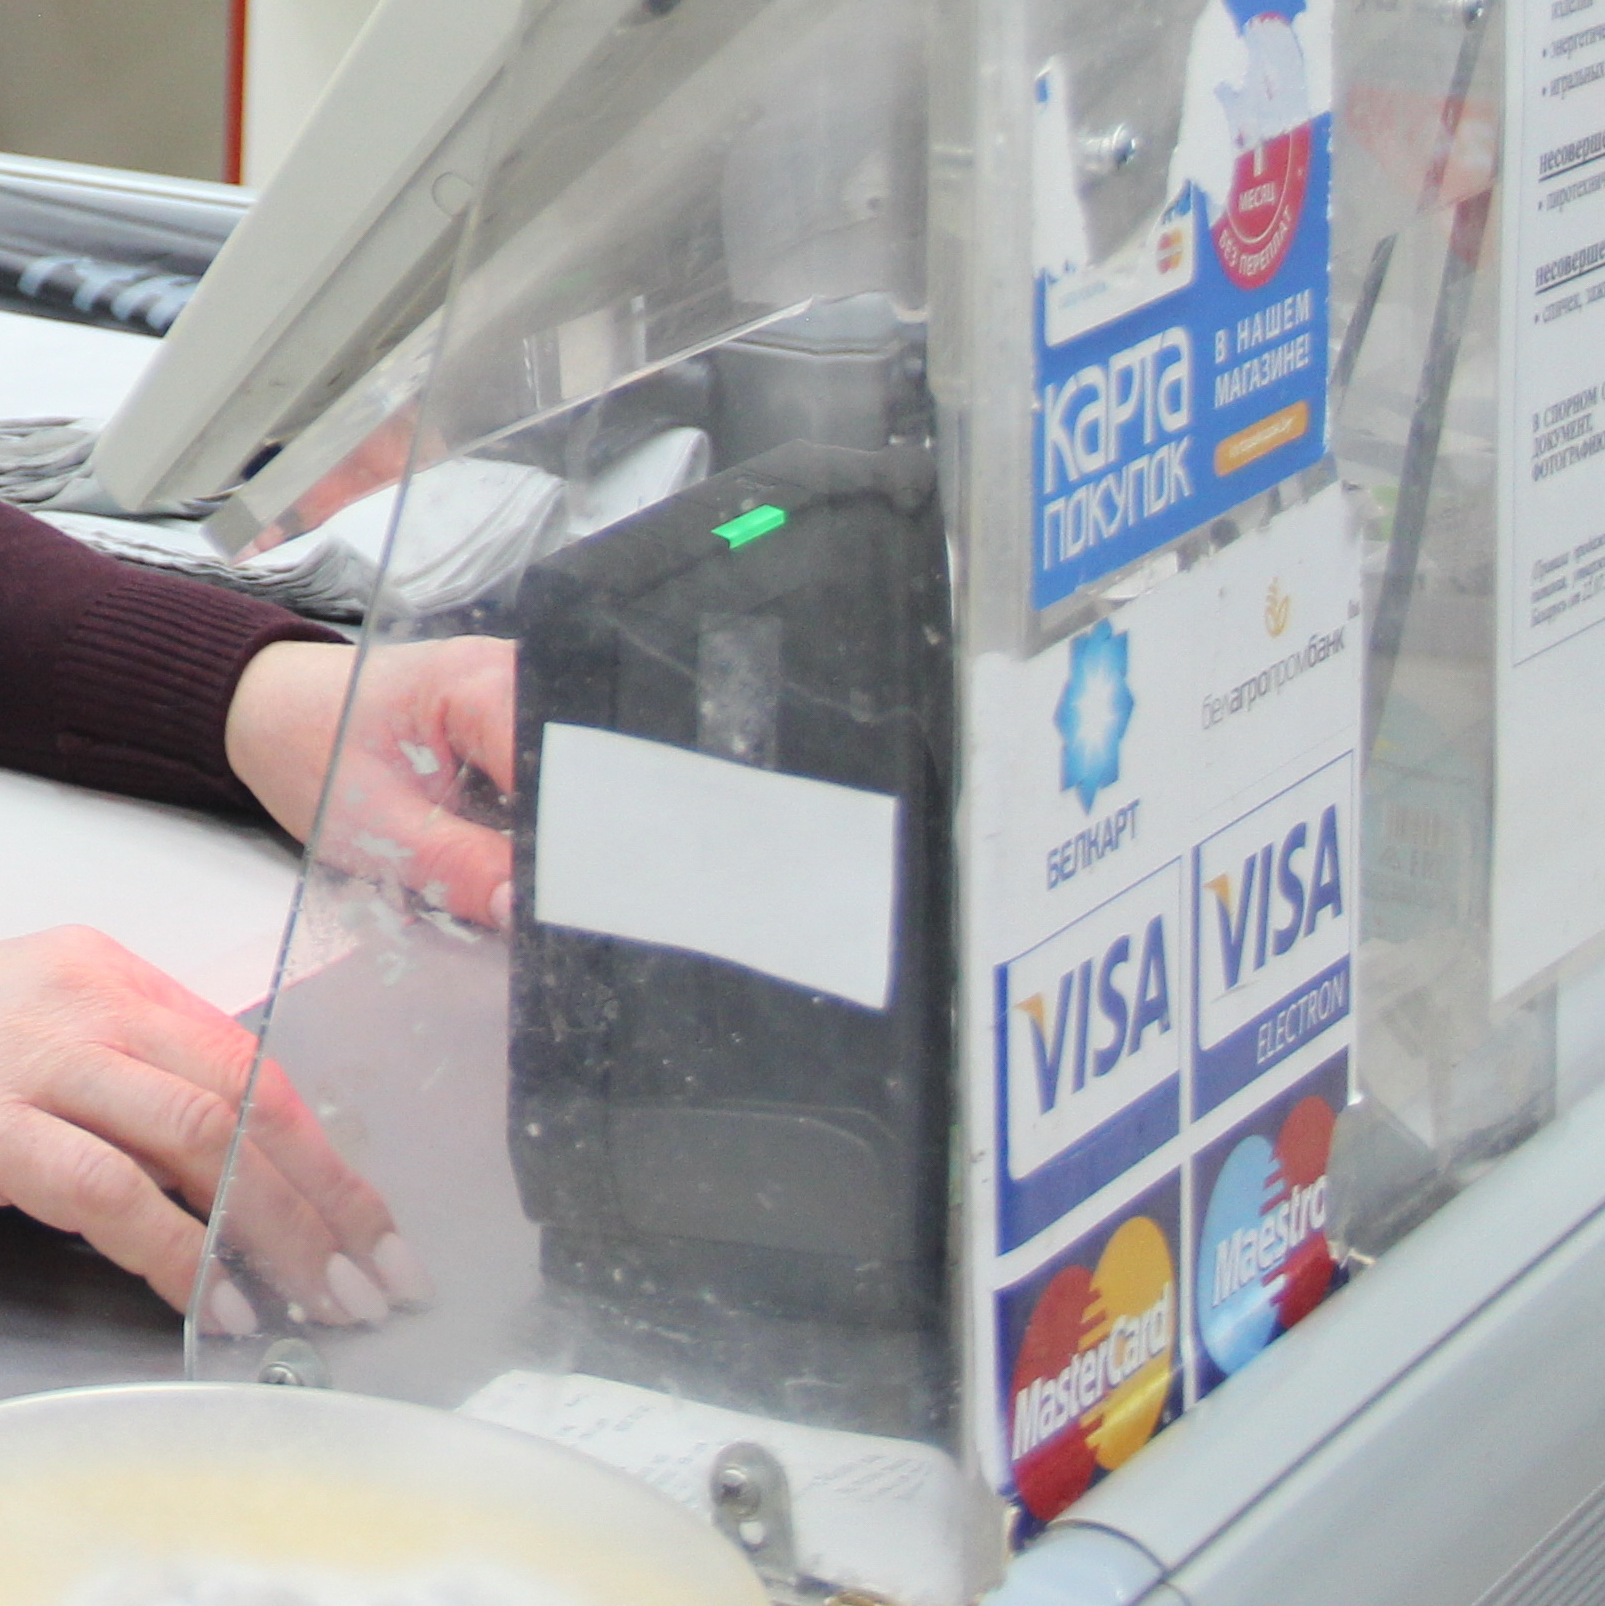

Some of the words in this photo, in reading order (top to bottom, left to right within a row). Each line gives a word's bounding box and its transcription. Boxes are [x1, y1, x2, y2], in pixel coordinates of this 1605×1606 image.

[1238, 181, 1277, 215] МЕСЯЦ
[1214, 328, 1228, 365] В
[1237, 288, 1310, 354] НАШЕМ
[1214, 332, 1310, 411] МАГАЗИНЕ!
[1046, 798, 1141, 891] БЕЛКАРТ
[1202, 803, 1344, 991] VISA
[1013, 914, 1172, 1116] VISA
[1255, 969, 1348, 1066] ELECTRON
[1212, 1174, 1328, 1308] Maestro
[1010, 1281, 1174, 1462] MasterCard
